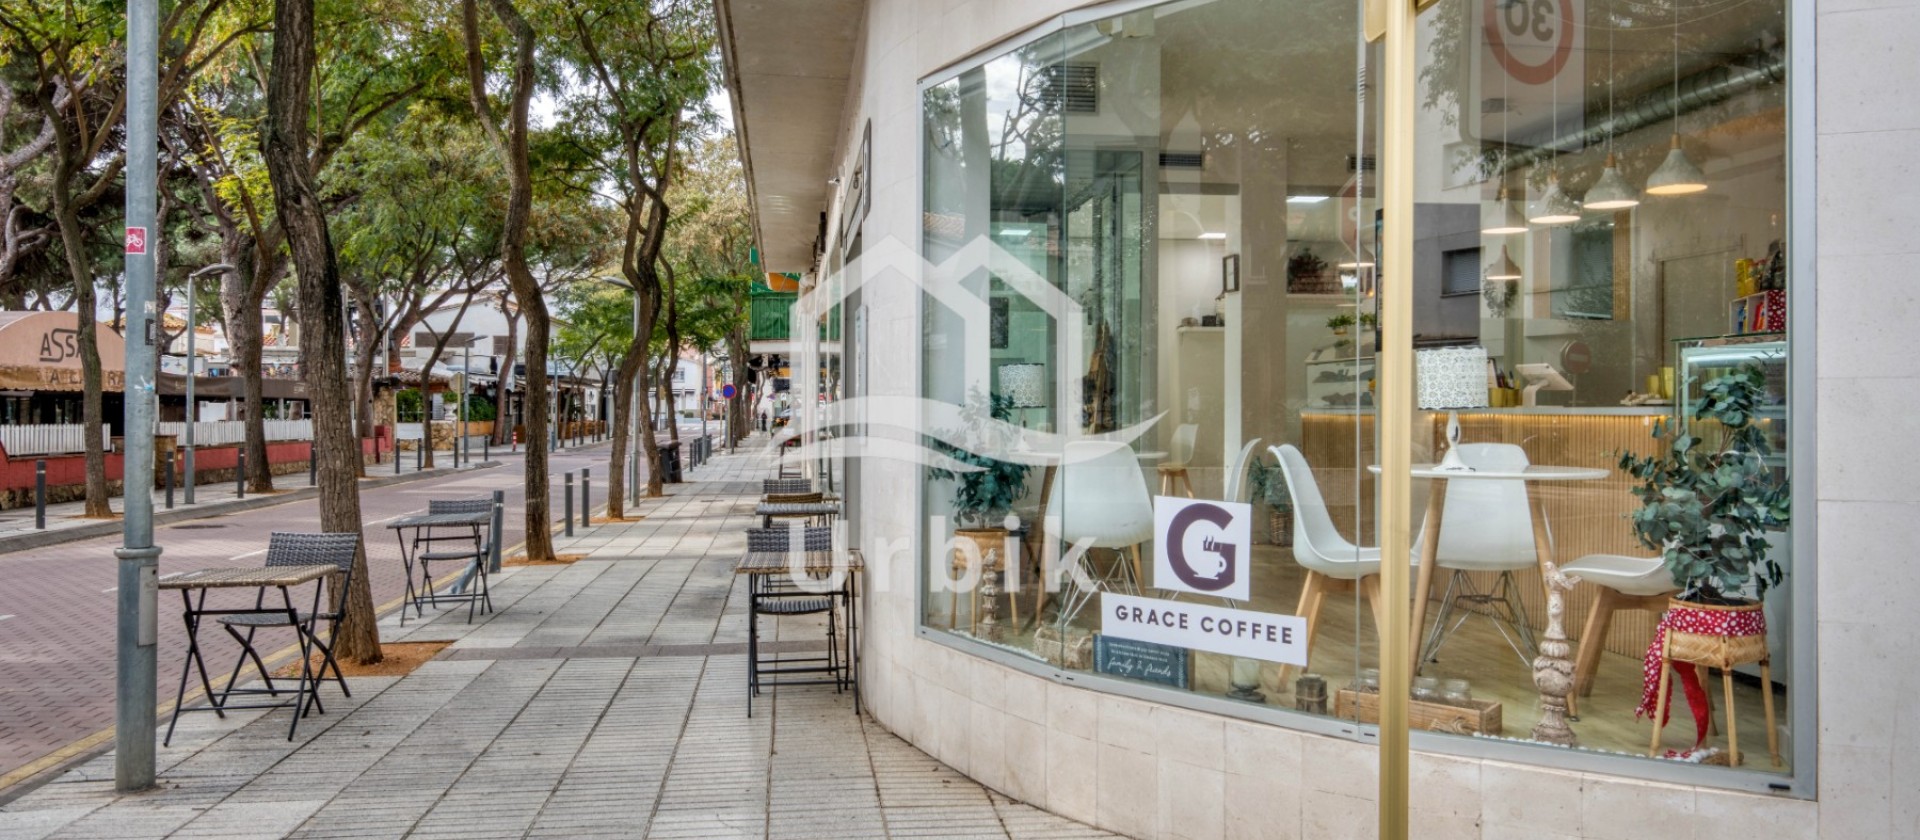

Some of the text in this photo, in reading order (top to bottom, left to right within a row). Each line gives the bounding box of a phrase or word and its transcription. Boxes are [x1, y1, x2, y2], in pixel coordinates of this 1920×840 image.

[1166, 503, 1236, 592] G
[1115, 604, 1292, 645] GRACE COFFEE
